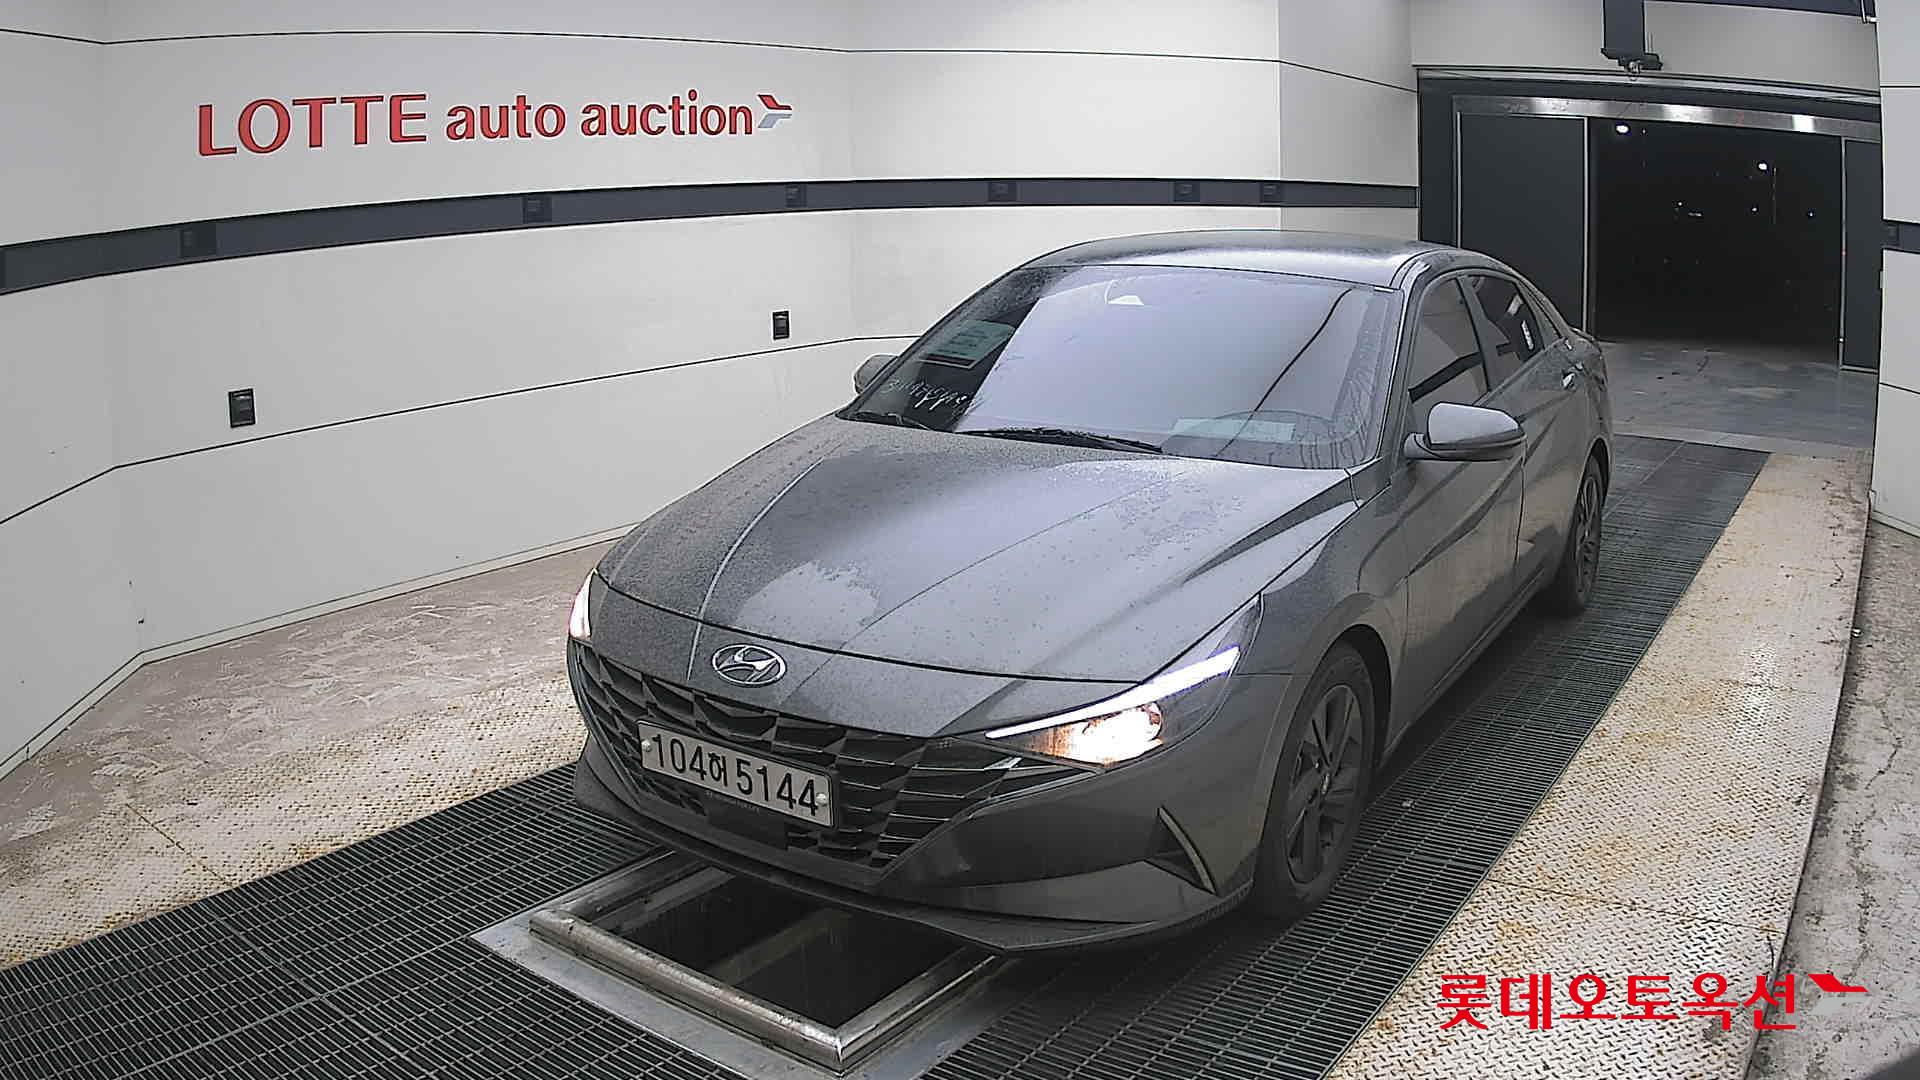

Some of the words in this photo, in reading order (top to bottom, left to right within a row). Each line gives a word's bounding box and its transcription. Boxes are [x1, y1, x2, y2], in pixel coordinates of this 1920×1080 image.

[199, 94, 427, 156] LOTTE
[446, 95, 566, 139] auto
[581, 89, 753, 136] auction
[652, 734, 728, 787] 104허
[736, 758, 818, 816] 5144
